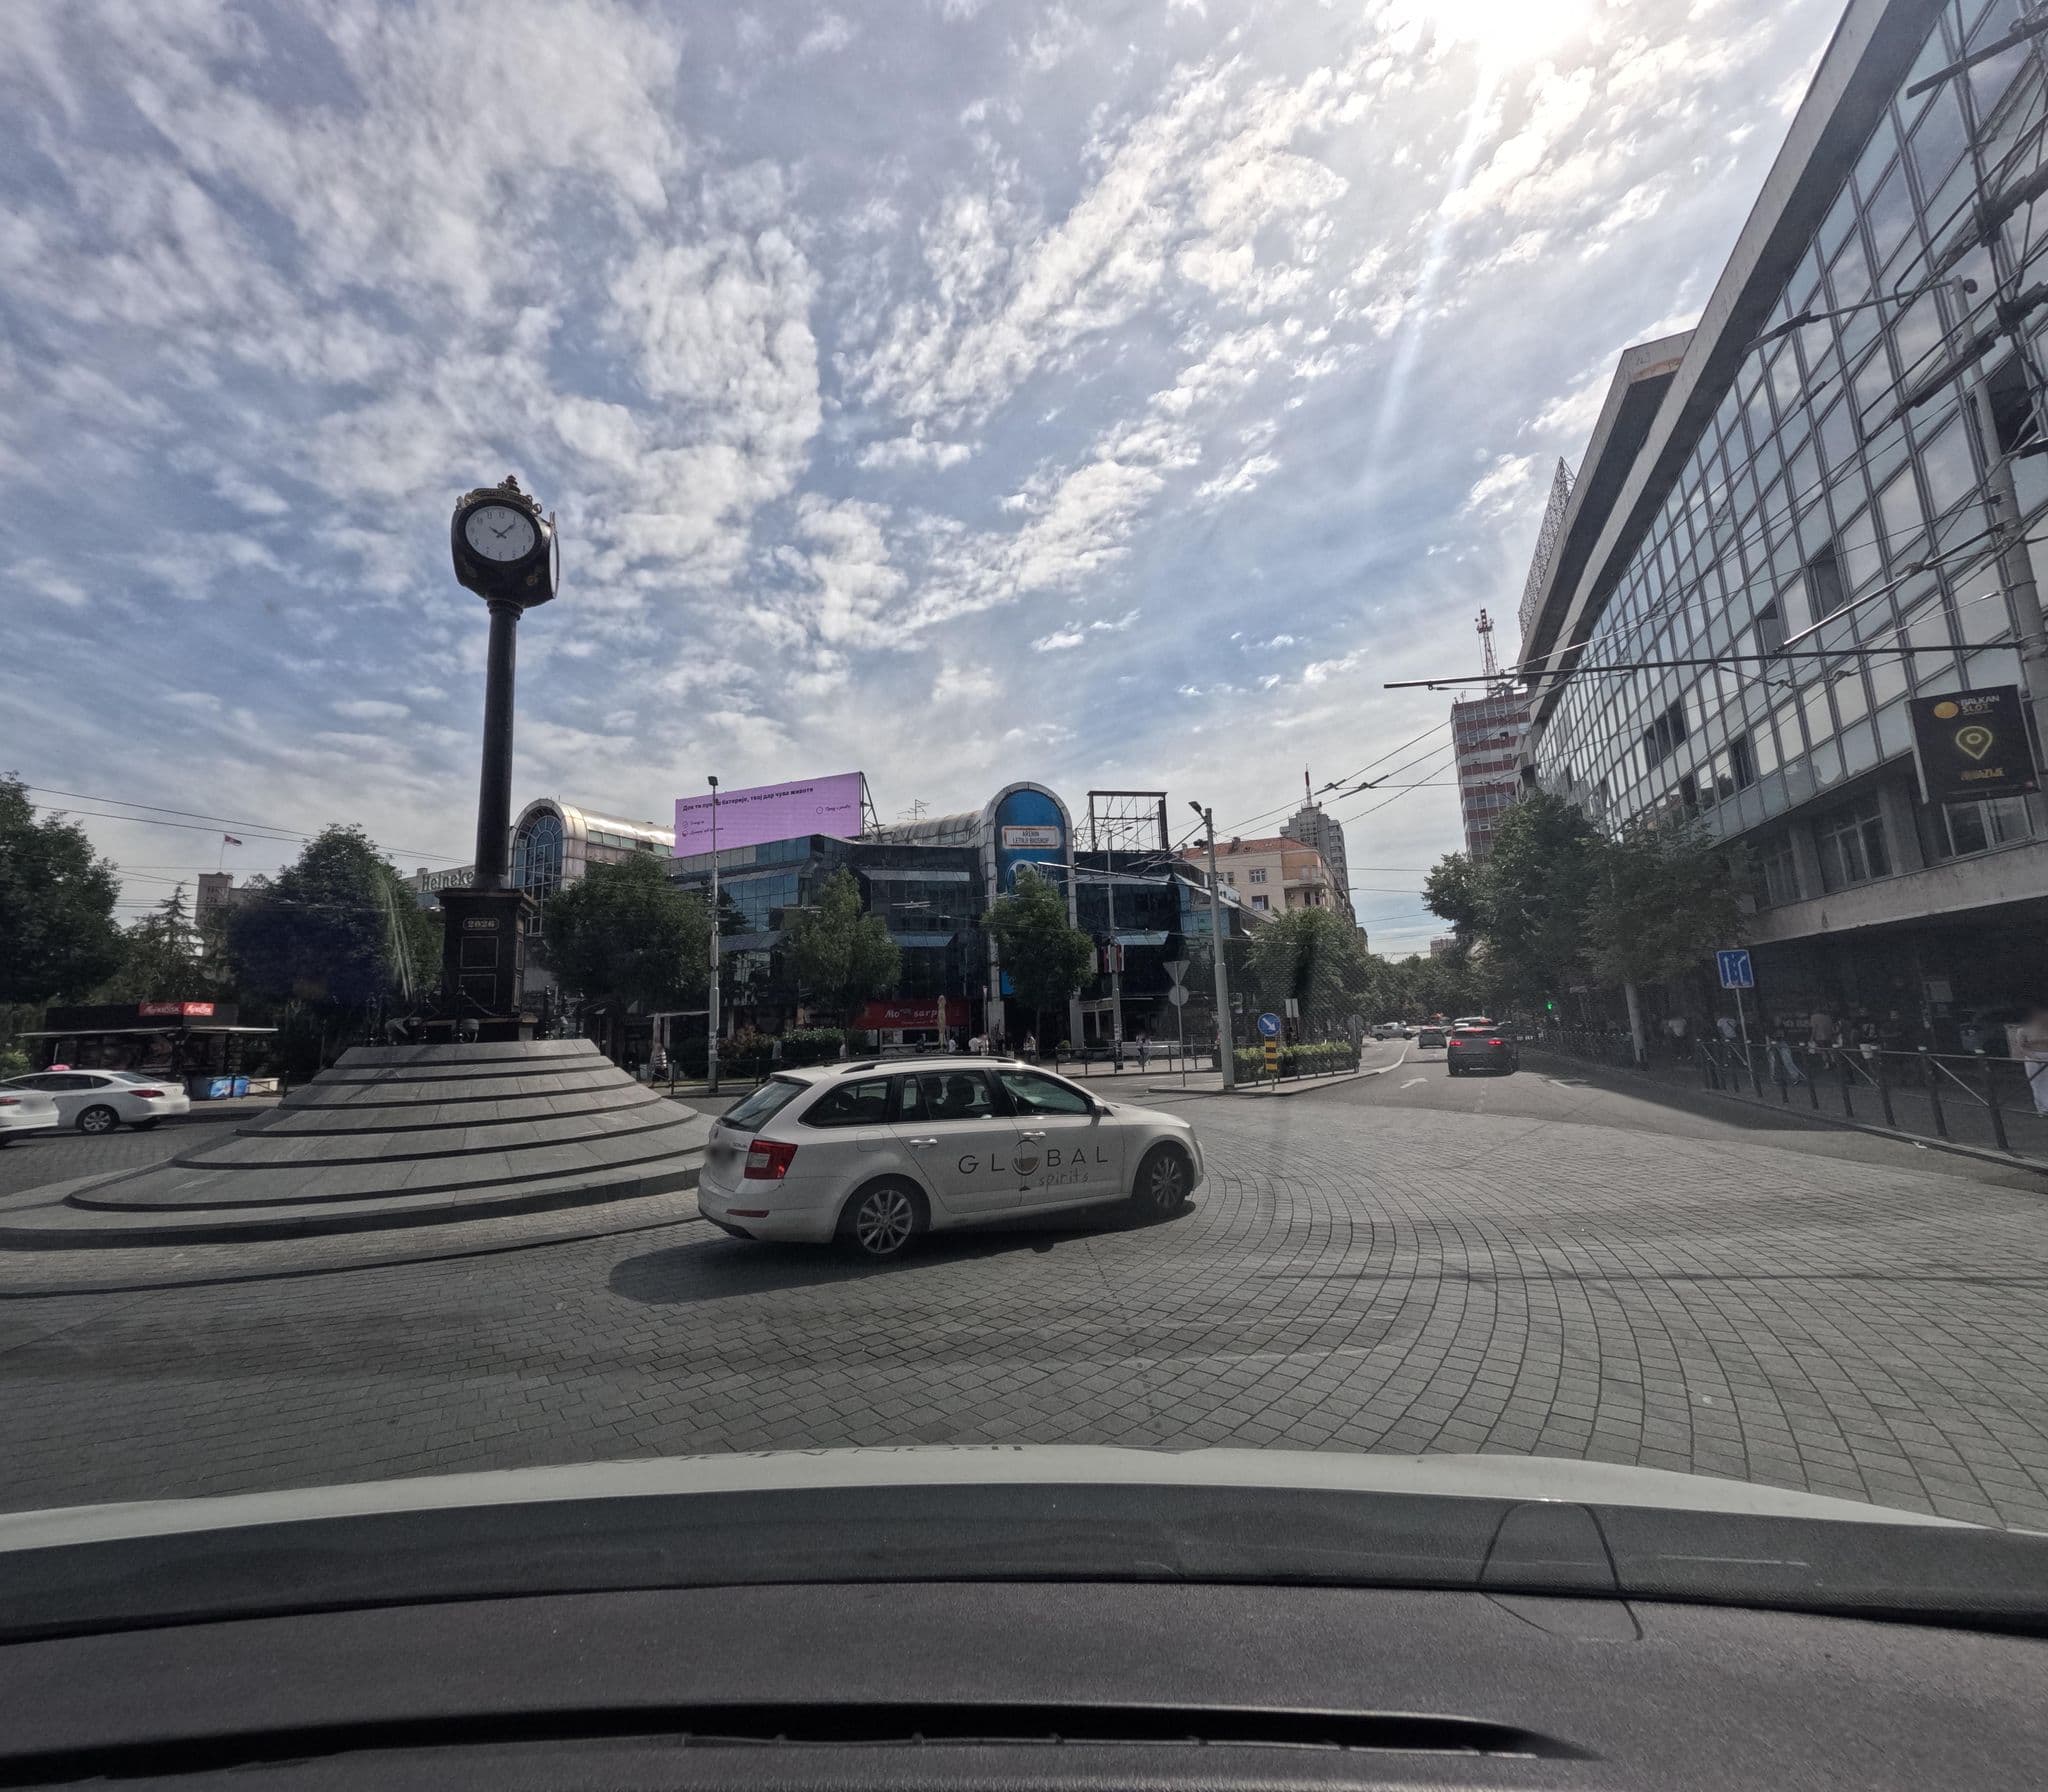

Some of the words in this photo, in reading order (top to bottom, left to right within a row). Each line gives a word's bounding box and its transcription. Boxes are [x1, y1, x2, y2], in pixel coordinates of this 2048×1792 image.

[1961, 695, 2000, 706] BALKAN
[422, 869, 475, 892] Heineke
[958, 1140, 1108, 1177] GLOBAL
[1039, 1169, 1089, 1187] spirits
